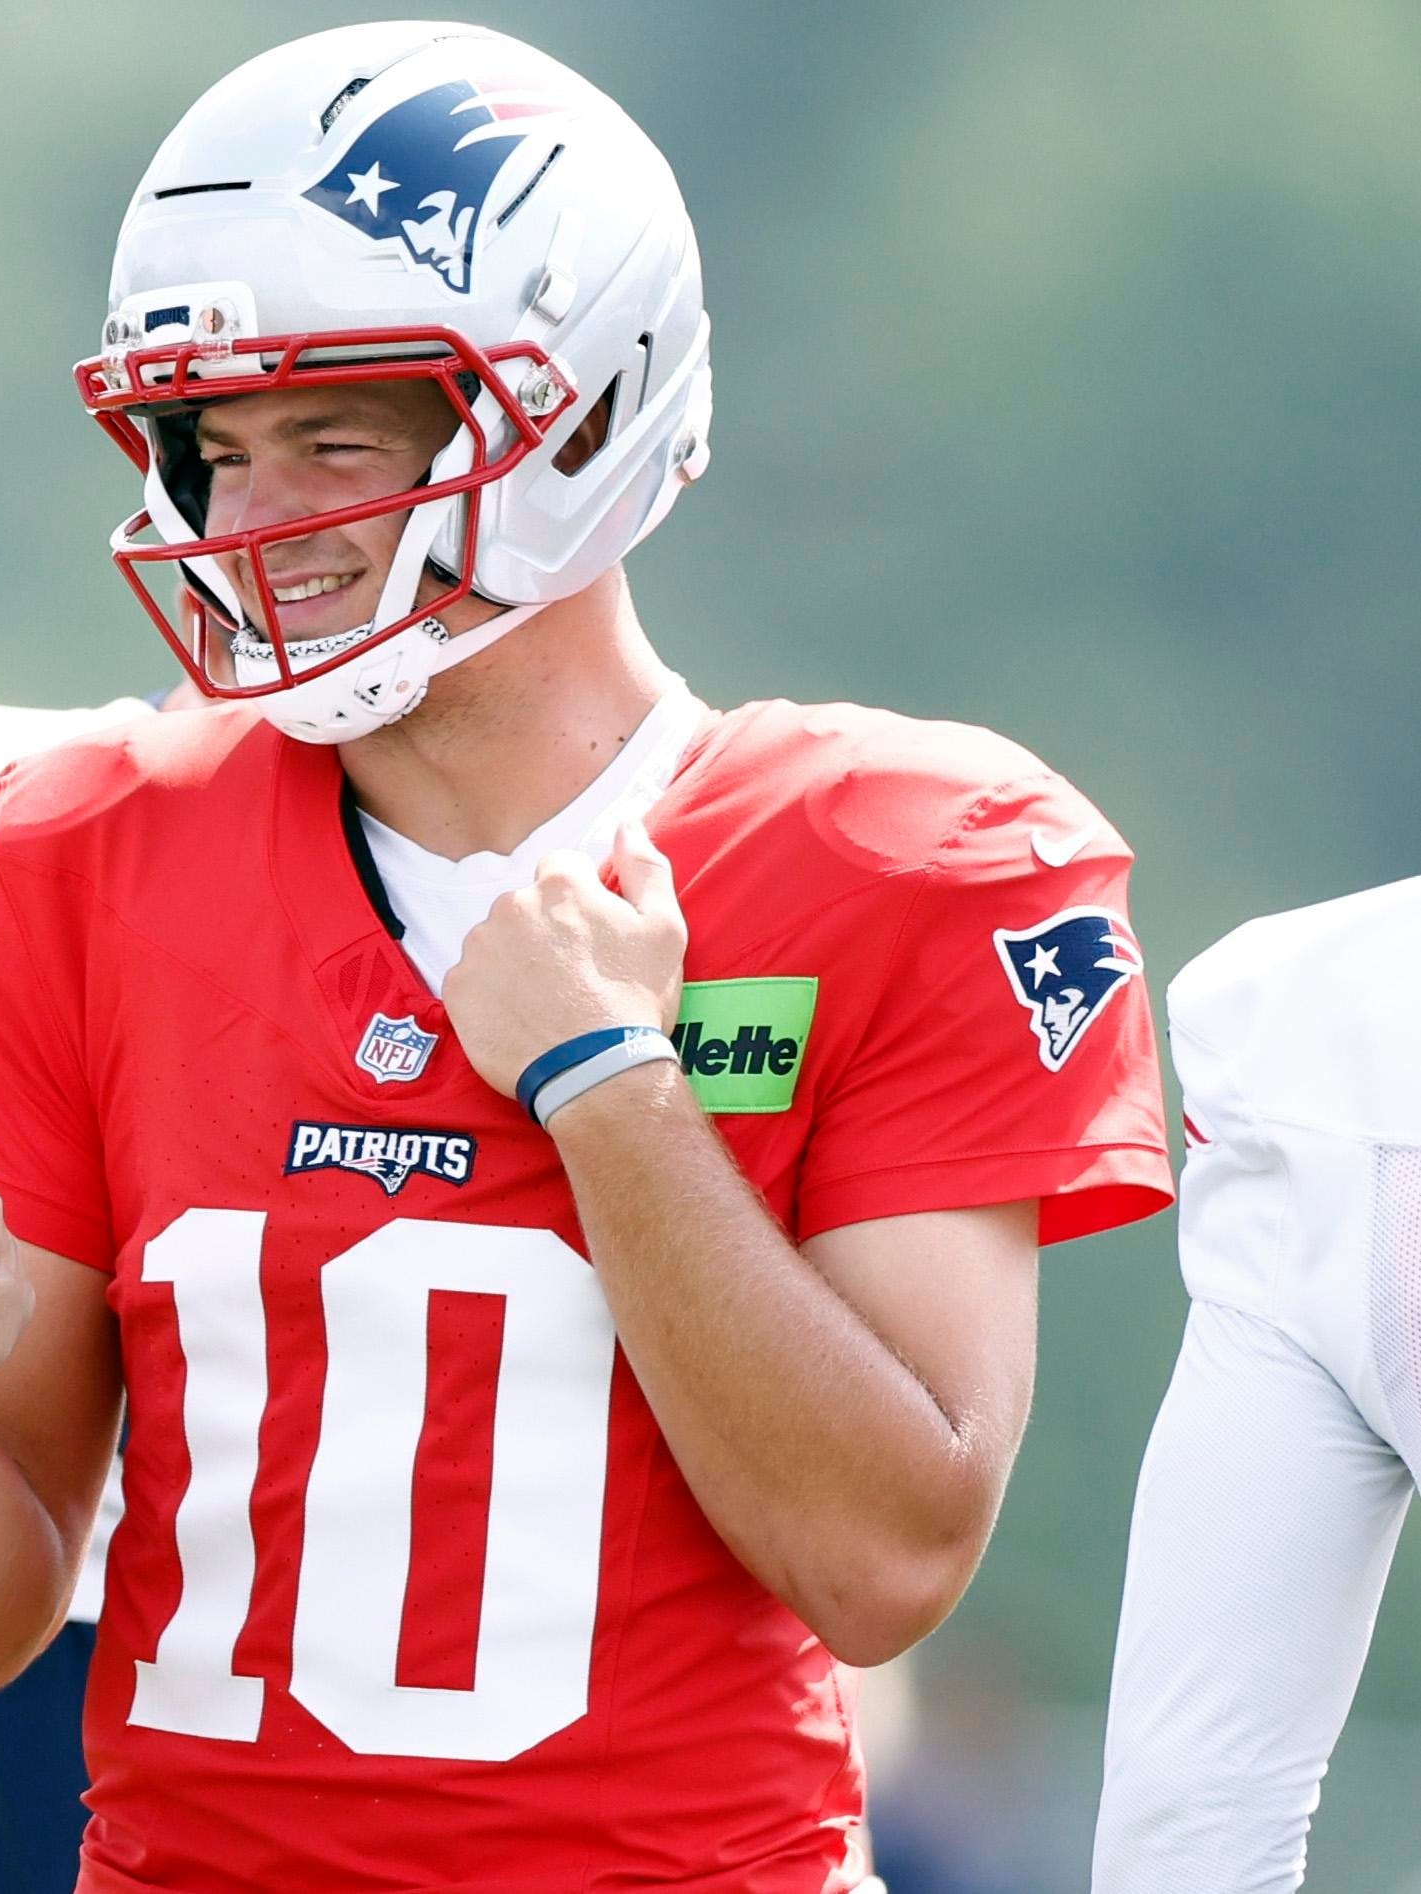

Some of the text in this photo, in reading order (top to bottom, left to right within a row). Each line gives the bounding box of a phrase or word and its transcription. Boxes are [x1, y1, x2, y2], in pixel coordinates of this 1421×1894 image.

[367, 1038, 414, 1071] NFL
[292, 1125, 471, 1180] PATRIOTS
[126, 1207, 617, 1763] 10
